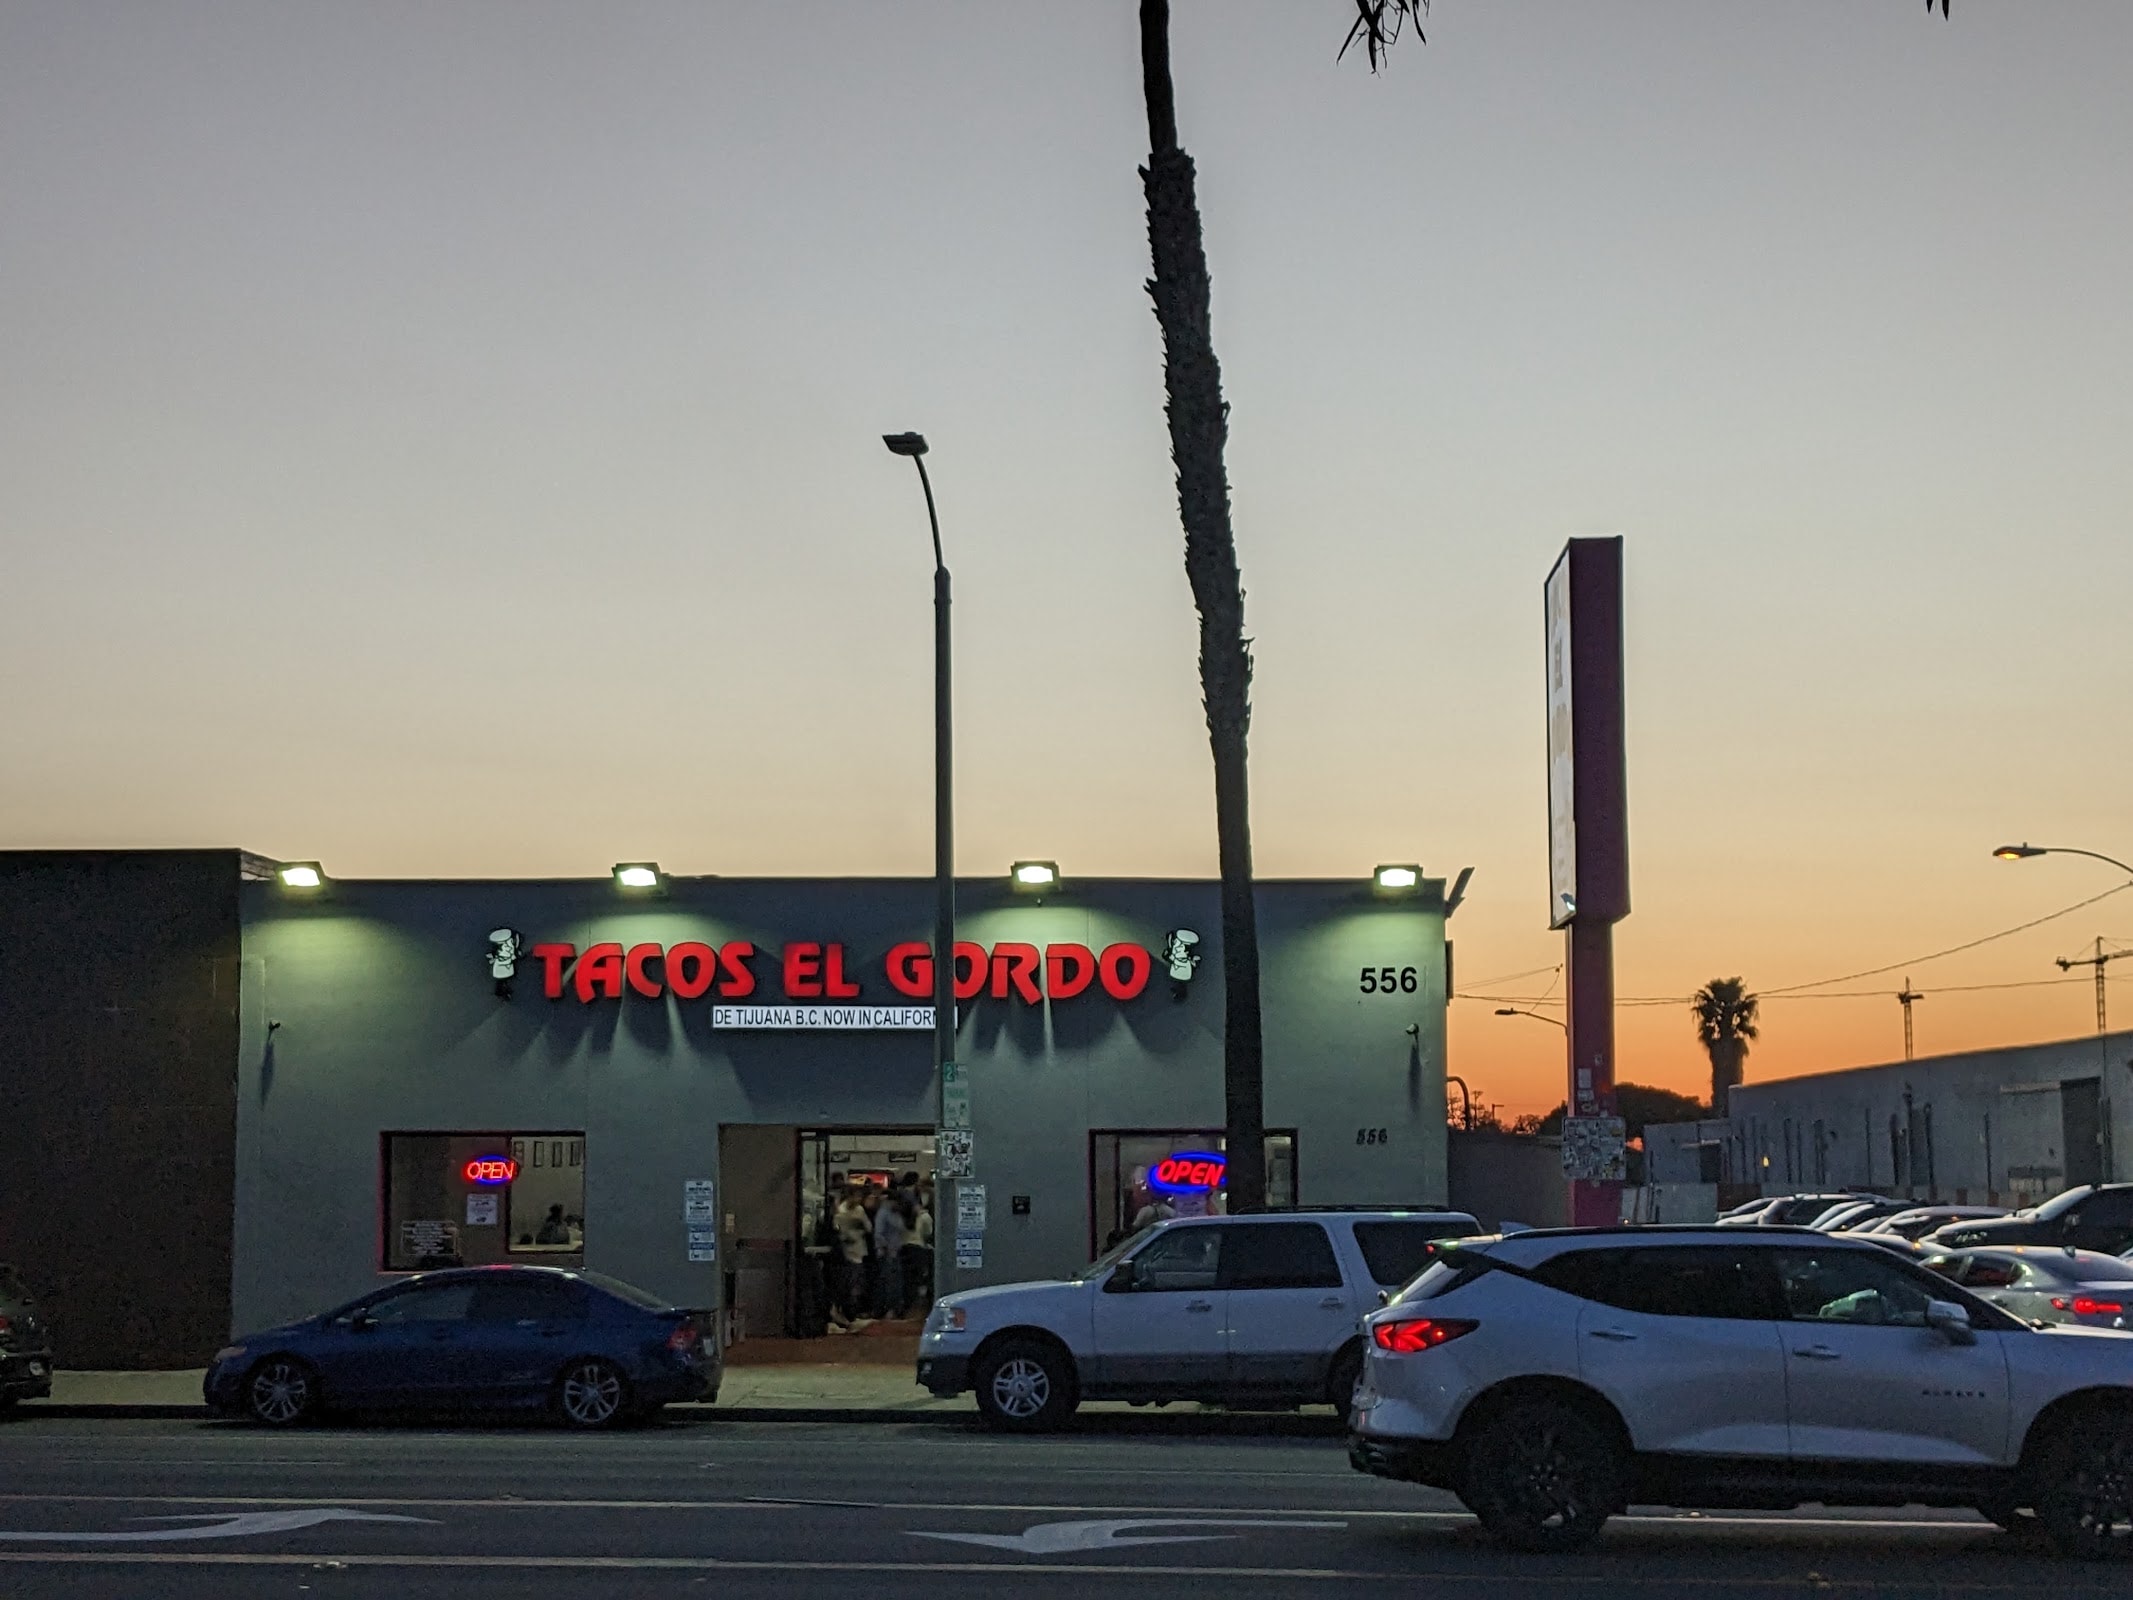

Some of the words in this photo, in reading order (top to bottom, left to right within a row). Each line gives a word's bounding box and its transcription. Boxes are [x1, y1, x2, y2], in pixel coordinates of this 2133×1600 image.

[532, 941, 756, 1003] TACOS
[783, 941, 860, 998] EL
[886, 941, 1151, 1005] GORDO
[1360, 967, 1417, 993] 556
[715, 1009, 732, 1025] DE
[736, 1009, 792, 1025] TIJUANA
[796, 1009, 821, 1025] B.C.
[824, 1009, 856, 1025] NOW
[859, 1009, 871, 1025] IN
[467, 1161, 514, 1179] OPEN
[1157, 1160, 1224, 1186] OPEN
